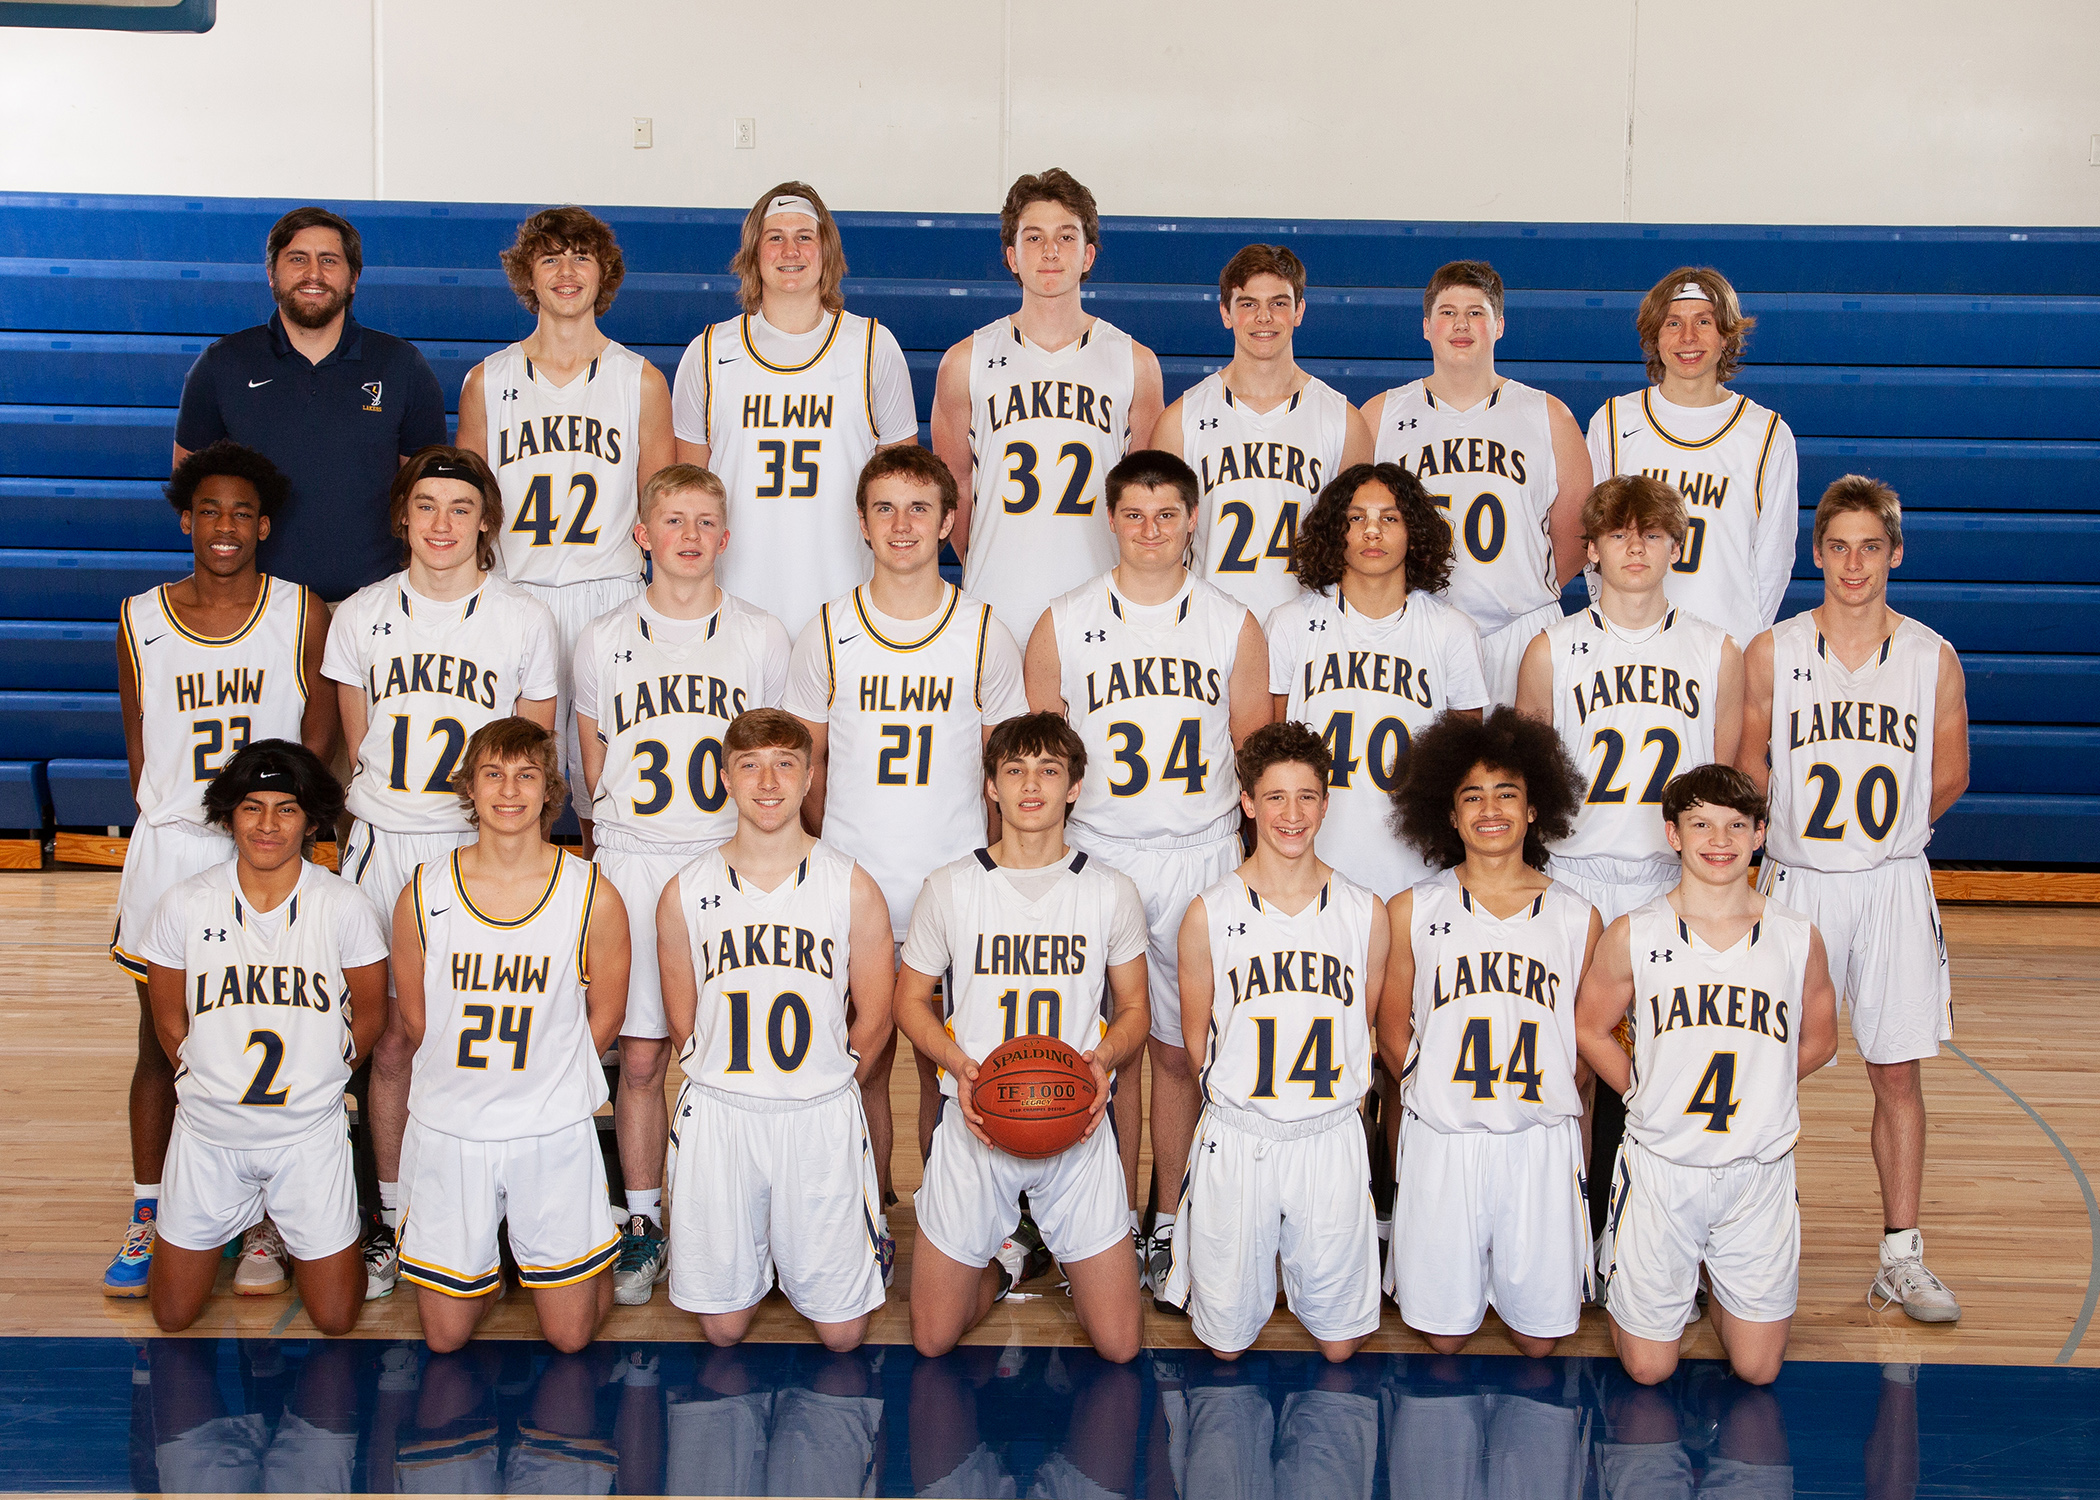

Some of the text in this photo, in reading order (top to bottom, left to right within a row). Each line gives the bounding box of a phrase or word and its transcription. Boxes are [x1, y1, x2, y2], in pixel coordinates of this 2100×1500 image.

[742, 394, 834, 429] HLWW
[987, 380, 1112, 434] LAKERS
[499, 415, 622, 468] LAKERS
[755, 439, 822, 499] 35
[1201, 442, 1322, 496] LAKERS
[1002, 440, 1097, 517] 32
[1641, 468, 1730, 510] WW
[509, 472, 602, 547] 42
[1215, 500, 1302, 574] 24
[175, 667, 265, 713] HLWW
[370, 653, 498, 710] LAKERS
[614, 674, 746, 737] LAKERS
[859, 675, 954, 713] HLWW
[1086, 657, 1221, 715] LAKERS
[1304, 651, 1432, 709] LAKERS
[1572, 664, 1700, 726] LAKERS
[192, 715, 251, 783] 23
[387, 714, 468, 795] 12
[876, 723, 934, 786] 21
[1106, 717, 1210, 798] 34
[1320, 710, 1414, 794] 40
[1790, 701, 1917, 754] LAKERS
[631, 736, 731, 817] 30
[1584, 726, 1681, 805] 22
[1800, 762, 1900, 843] 20
[451, 952, 551, 994] HLWW
[702, 923, 834, 985] LAKERS
[974, 933, 1087, 976] LAKERS
[1227, 950, 1354, 1008] LAKERS
[1433, 951, 1561, 1012] LAKERS
[194, 964, 331, 1017] LAKERS
[997, 988, 1062, 1042] 10
[1649, 984, 1788, 1044] LAKERS
[456, 1003, 534, 1071] 24
[721, 990, 813, 1074] 10
[992, 1048, 1074, 1073] SPALDING
[1248, 1016, 1344, 1100] 14
[1451, 1017, 1544, 1104] 44
[238, 1028, 291, 1107] 2
[997, 1084, 1076, 1100] TF-1000
[1682, 1050, 1742, 1134] 4
[1020, 1099, 1054, 1107] LEGACY
